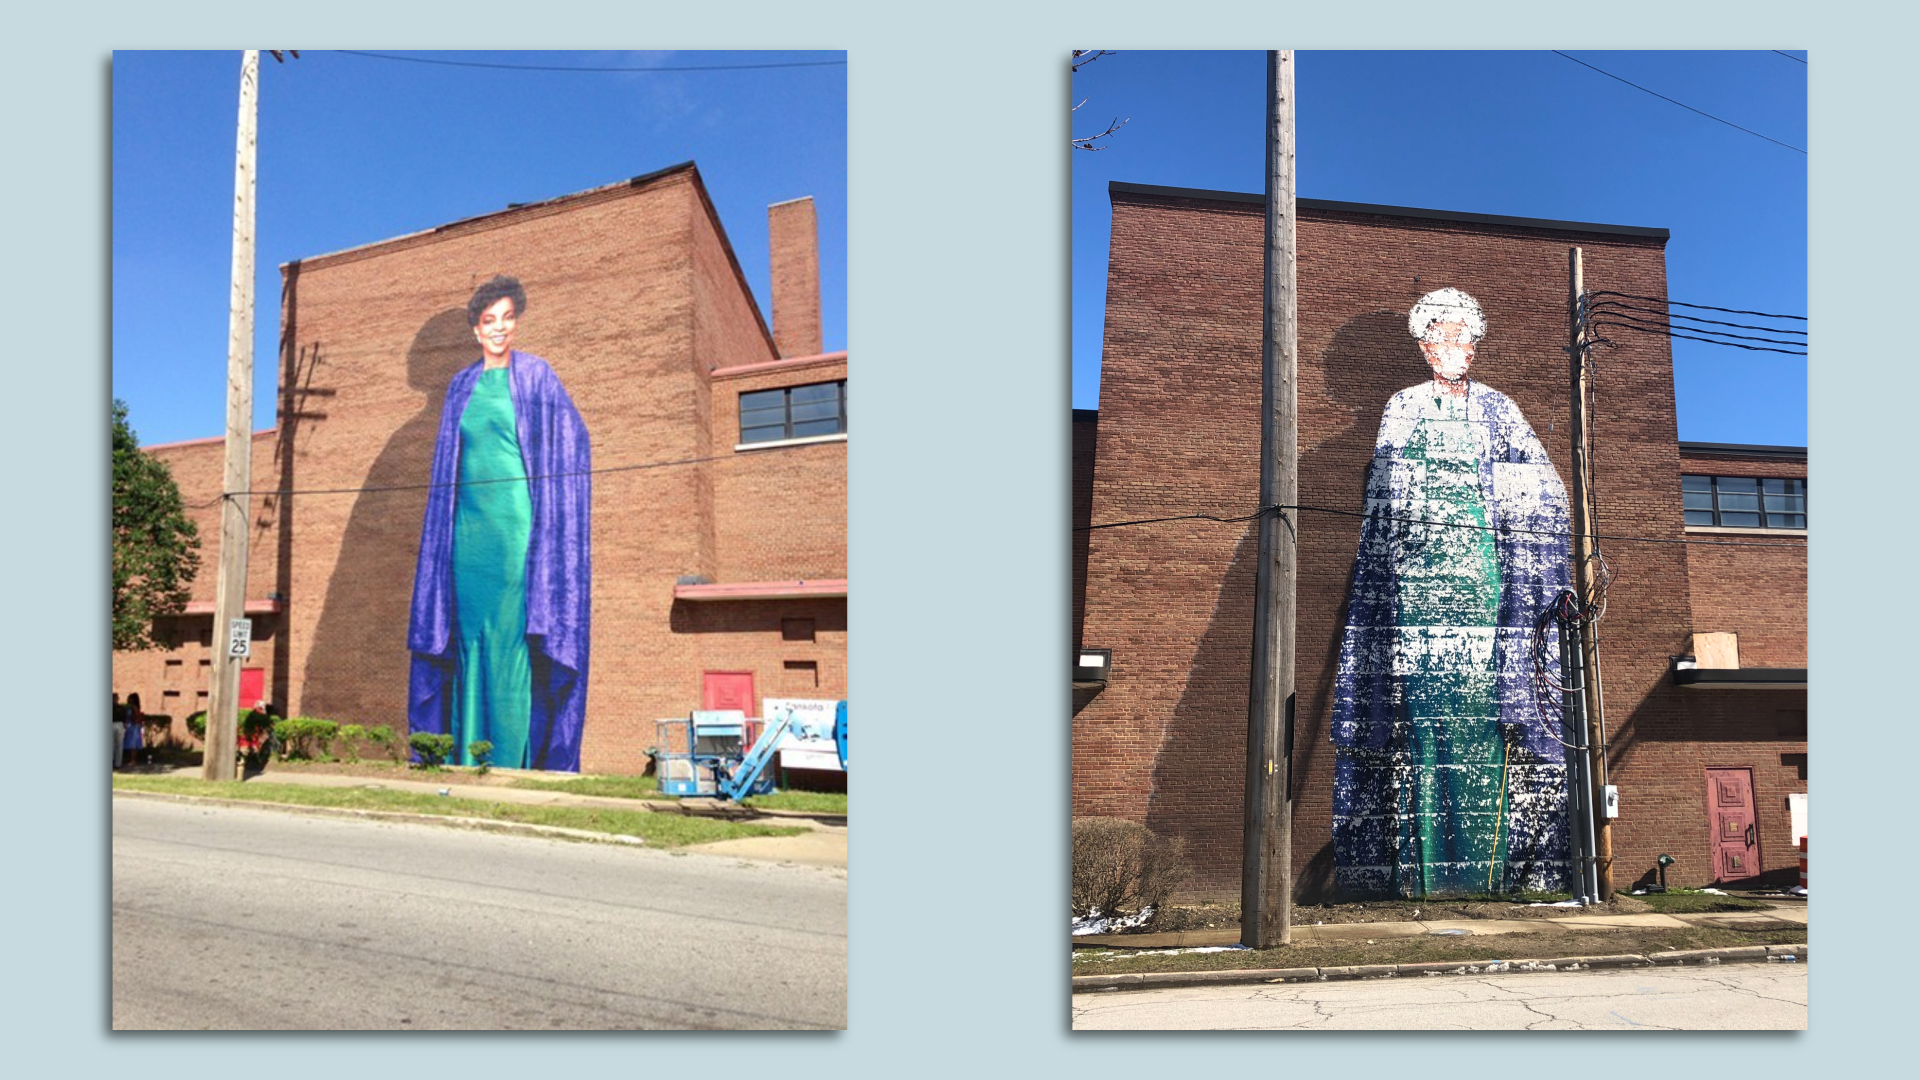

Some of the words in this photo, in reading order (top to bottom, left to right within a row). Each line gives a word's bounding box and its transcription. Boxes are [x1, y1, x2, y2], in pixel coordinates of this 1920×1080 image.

[231, 621, 250, 630] SPEED
[232, 630, 248, 638] LIMIT
[231, 639, 247, 654] 25
